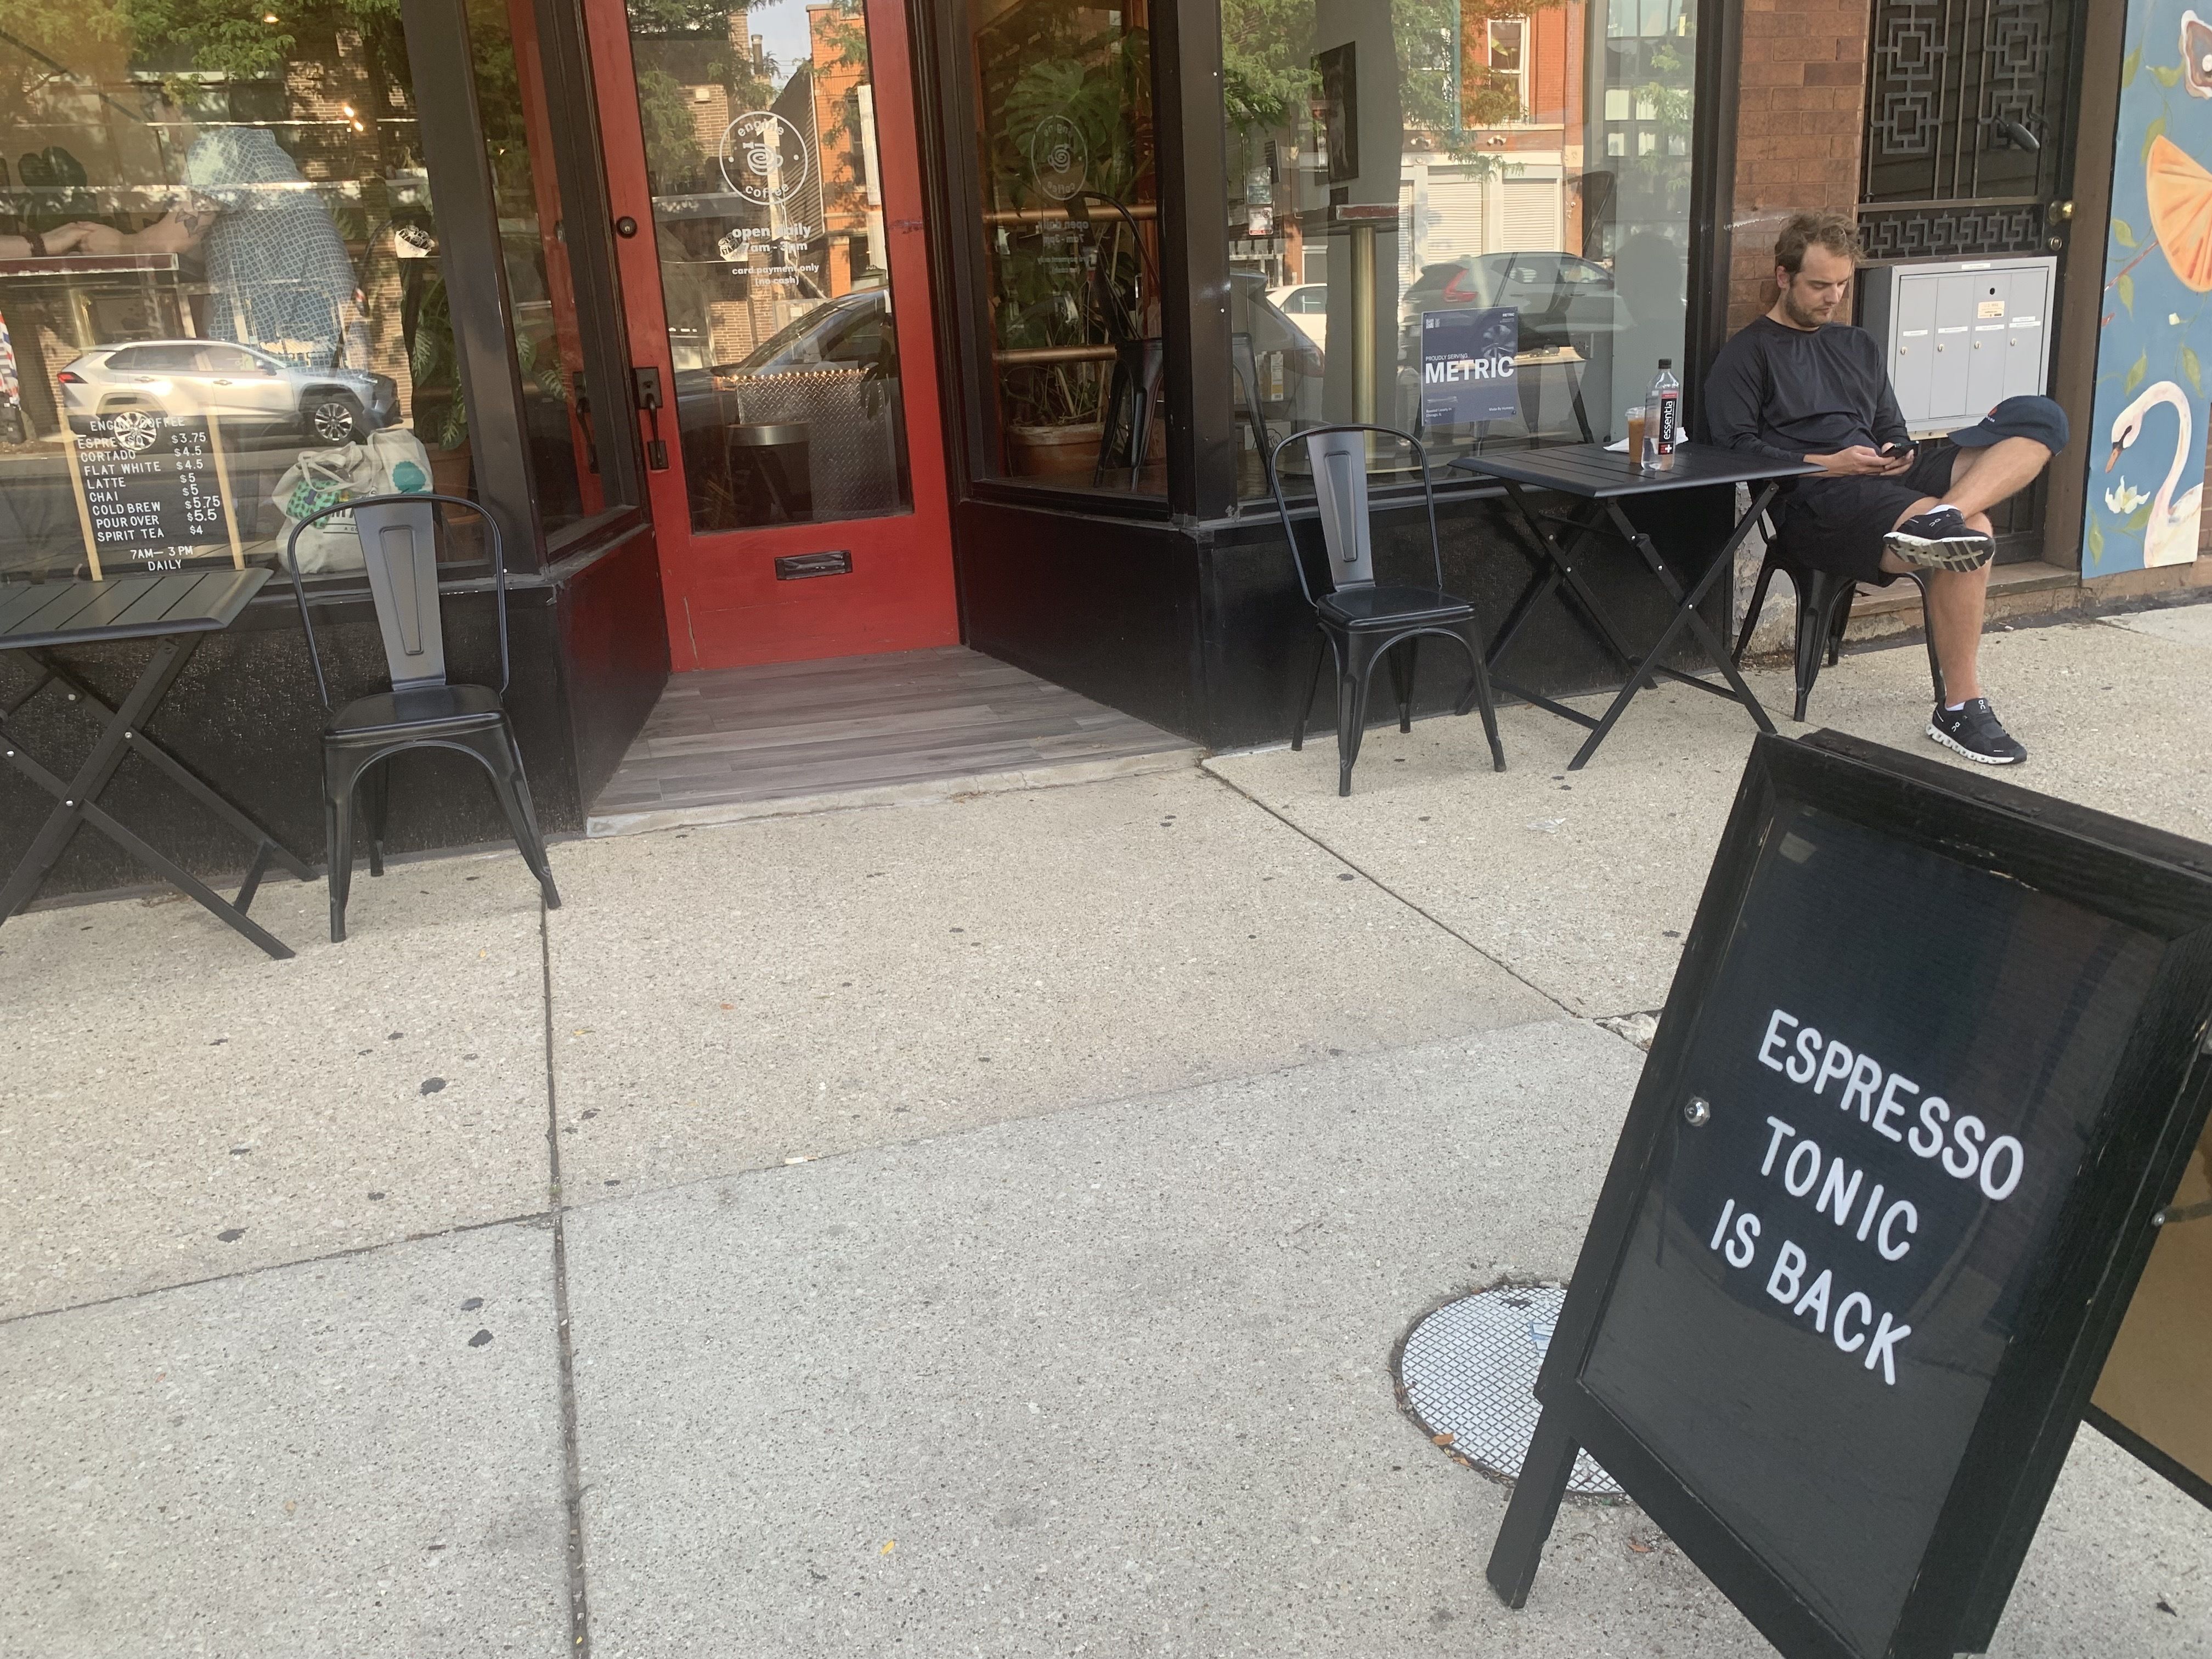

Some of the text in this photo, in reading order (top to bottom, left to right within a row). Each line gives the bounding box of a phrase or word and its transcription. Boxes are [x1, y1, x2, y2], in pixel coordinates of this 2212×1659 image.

[737, 118, 784, 137] engine
[746, 184, 789, 198] coffee
[732, 222, 812, 241] open daily
[742, 242, 771, 252] 7am
[780, 241, 808, 254] 3pm
[732, 263, 820, 275] card payment only
[1425, 356, 1514, 383] METRIC
[90, 417, 185, 432] ENGIN COFFEE
[1663, 400, 1672, 439] essentia
[77, 436, 144, 449] ESPRESO
[171, 432, 207, 444] $3.75
[80, 450, 136, 462] CORTADO
[174, 445, 202, 457] $4.5
[84, 461, 161, 476] FLAT WHITE
[176, 459, 204, 470] $4.5
[87, 477, 126, 489] LATTE
[179, 472, 196, 483] $5
[182, 484, 199, 496] $5
[89, 491, 119, 503] CHAI
[184, 495, 221, 509] $5.75
[92, 501, 161, 516] COLD BREW
[96, 515, 160, 528] POUR OVER
[187, 509, 217, 522] $5.5
[97, 528, 165, 542] SPIRIT TEA
[190, 524, 203, 535] $4
[148, 559, 182, 571] DAILY
[1758, 1008, 2025, 1200] ESPRESSO
[1760, 1116, 1919, 1261] TONIC
[1710, 1199, 1912, 1386] IS BACK
